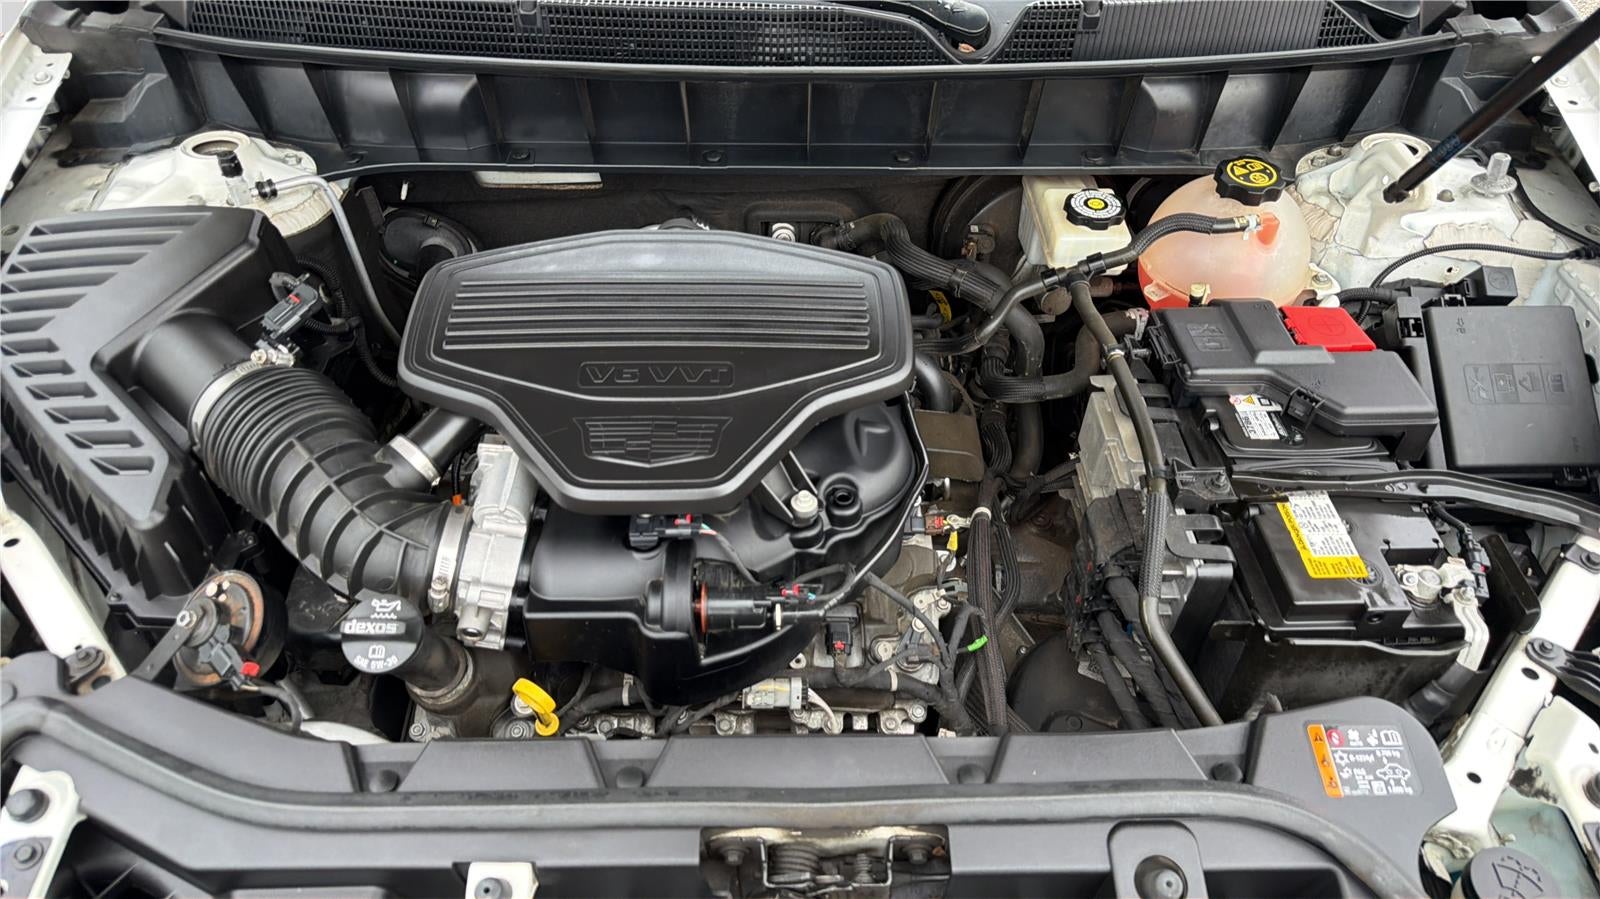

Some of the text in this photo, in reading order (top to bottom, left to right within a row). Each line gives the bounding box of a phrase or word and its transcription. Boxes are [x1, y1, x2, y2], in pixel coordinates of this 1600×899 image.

[586, 367, 728, 382] V6 VVT
[344, 619, 397, 634] dexos
